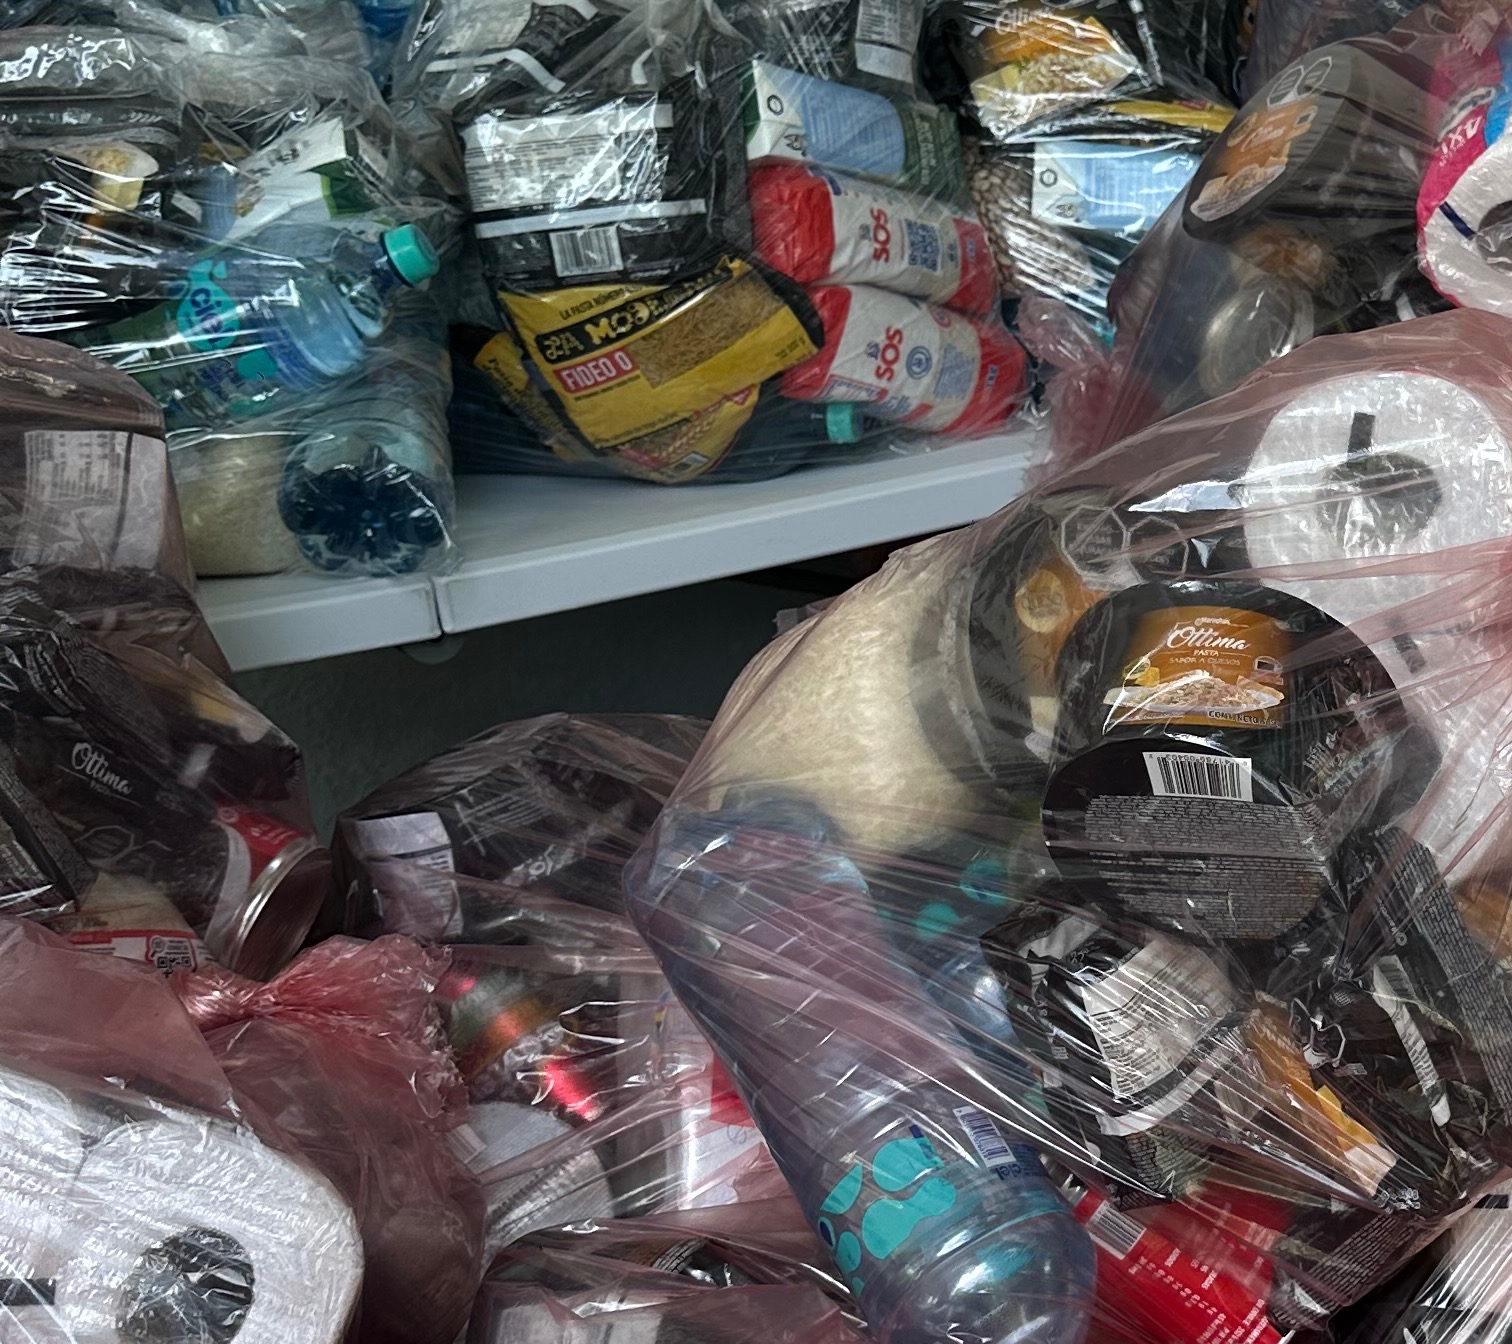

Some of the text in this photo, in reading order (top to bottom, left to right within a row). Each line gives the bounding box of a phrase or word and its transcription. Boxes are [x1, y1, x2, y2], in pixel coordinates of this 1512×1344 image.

[870, 208, 892, 263] SOS
[875, 326, 904, 382] SOS
[561, 355, 617, 391] FIDEO
[1166, 625, 1251, 651] Ottima
[1193, 649, 1220, 658] PASTA
[71, 742, 133, 795] Ottima
[995, 1164, 1022, 1181] ciel
